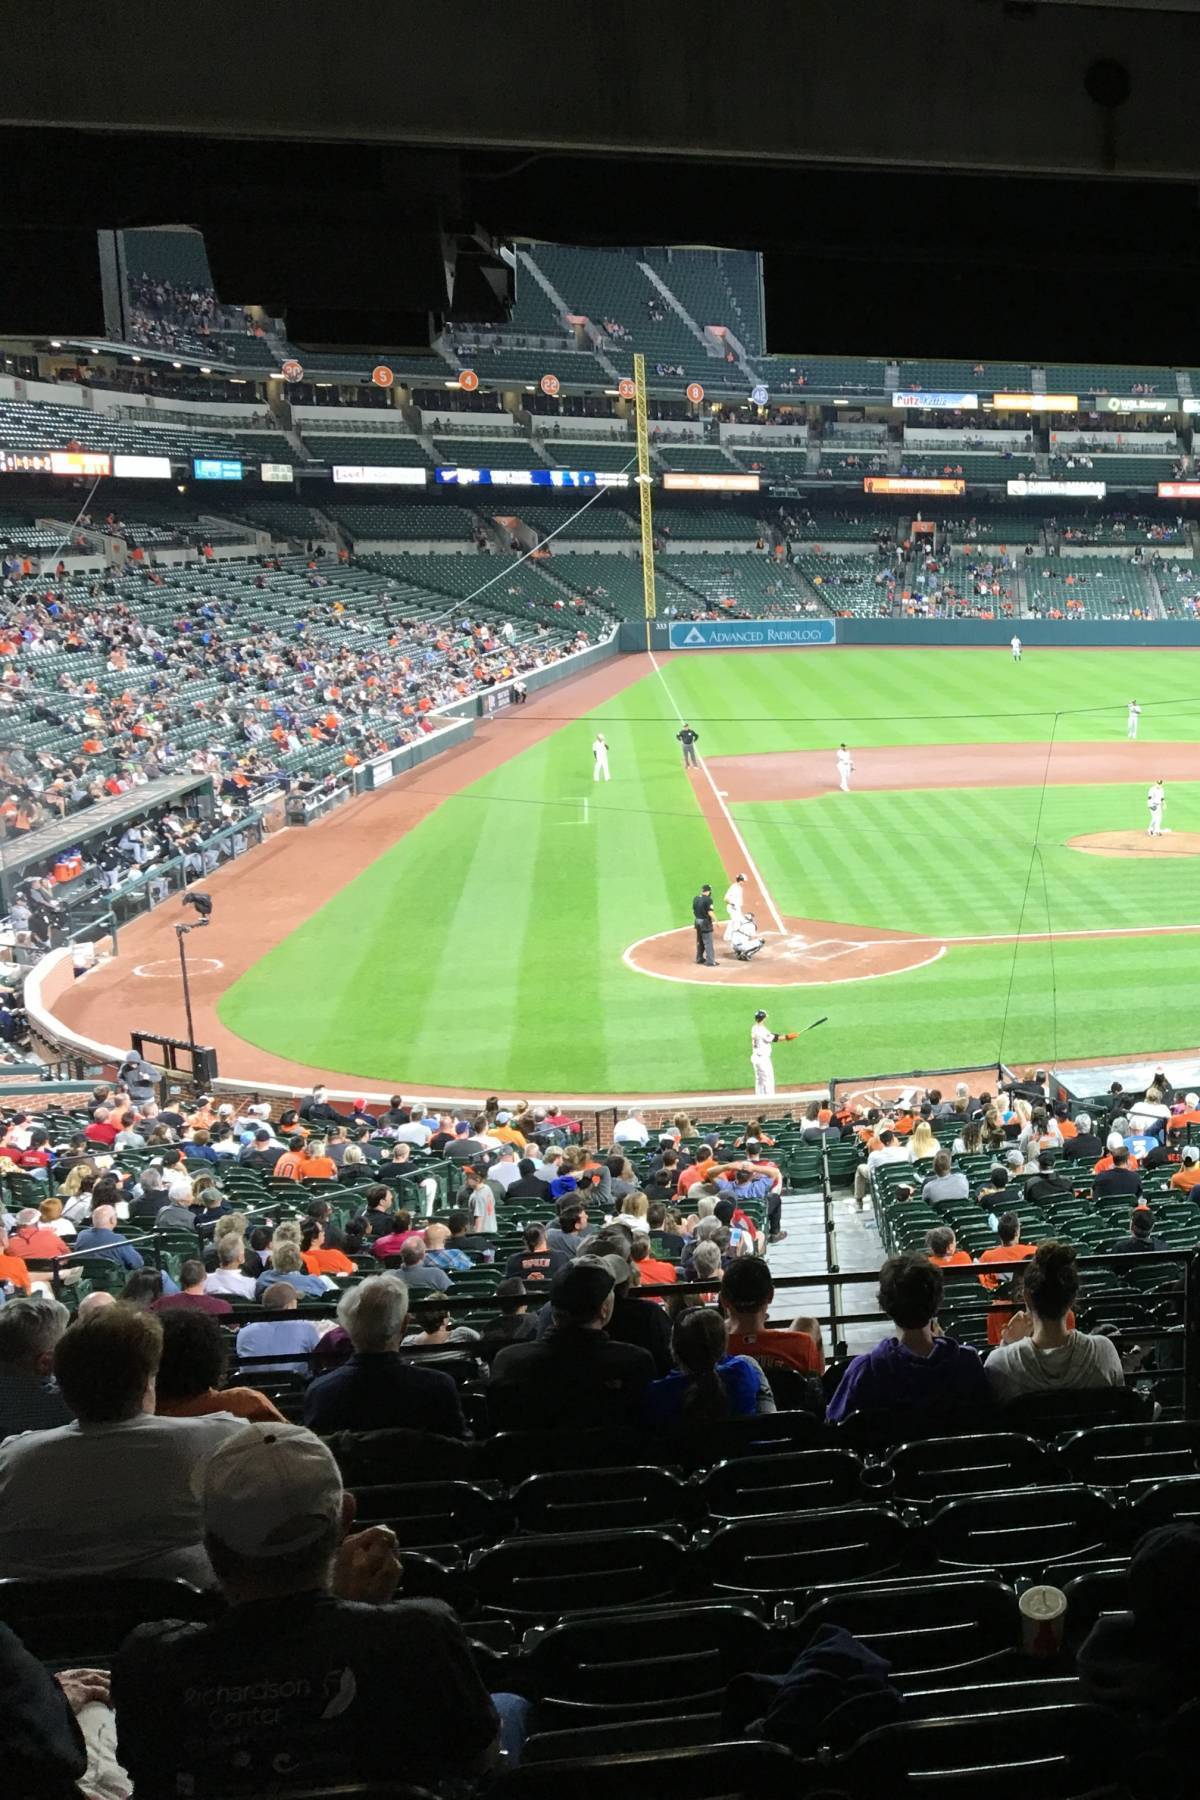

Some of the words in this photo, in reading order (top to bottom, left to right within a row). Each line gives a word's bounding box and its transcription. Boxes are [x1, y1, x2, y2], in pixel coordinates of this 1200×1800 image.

[542, 379, 558, 390] 22
[621, 383, 634, 395] 33
[754, 389, 766, 401] 42
